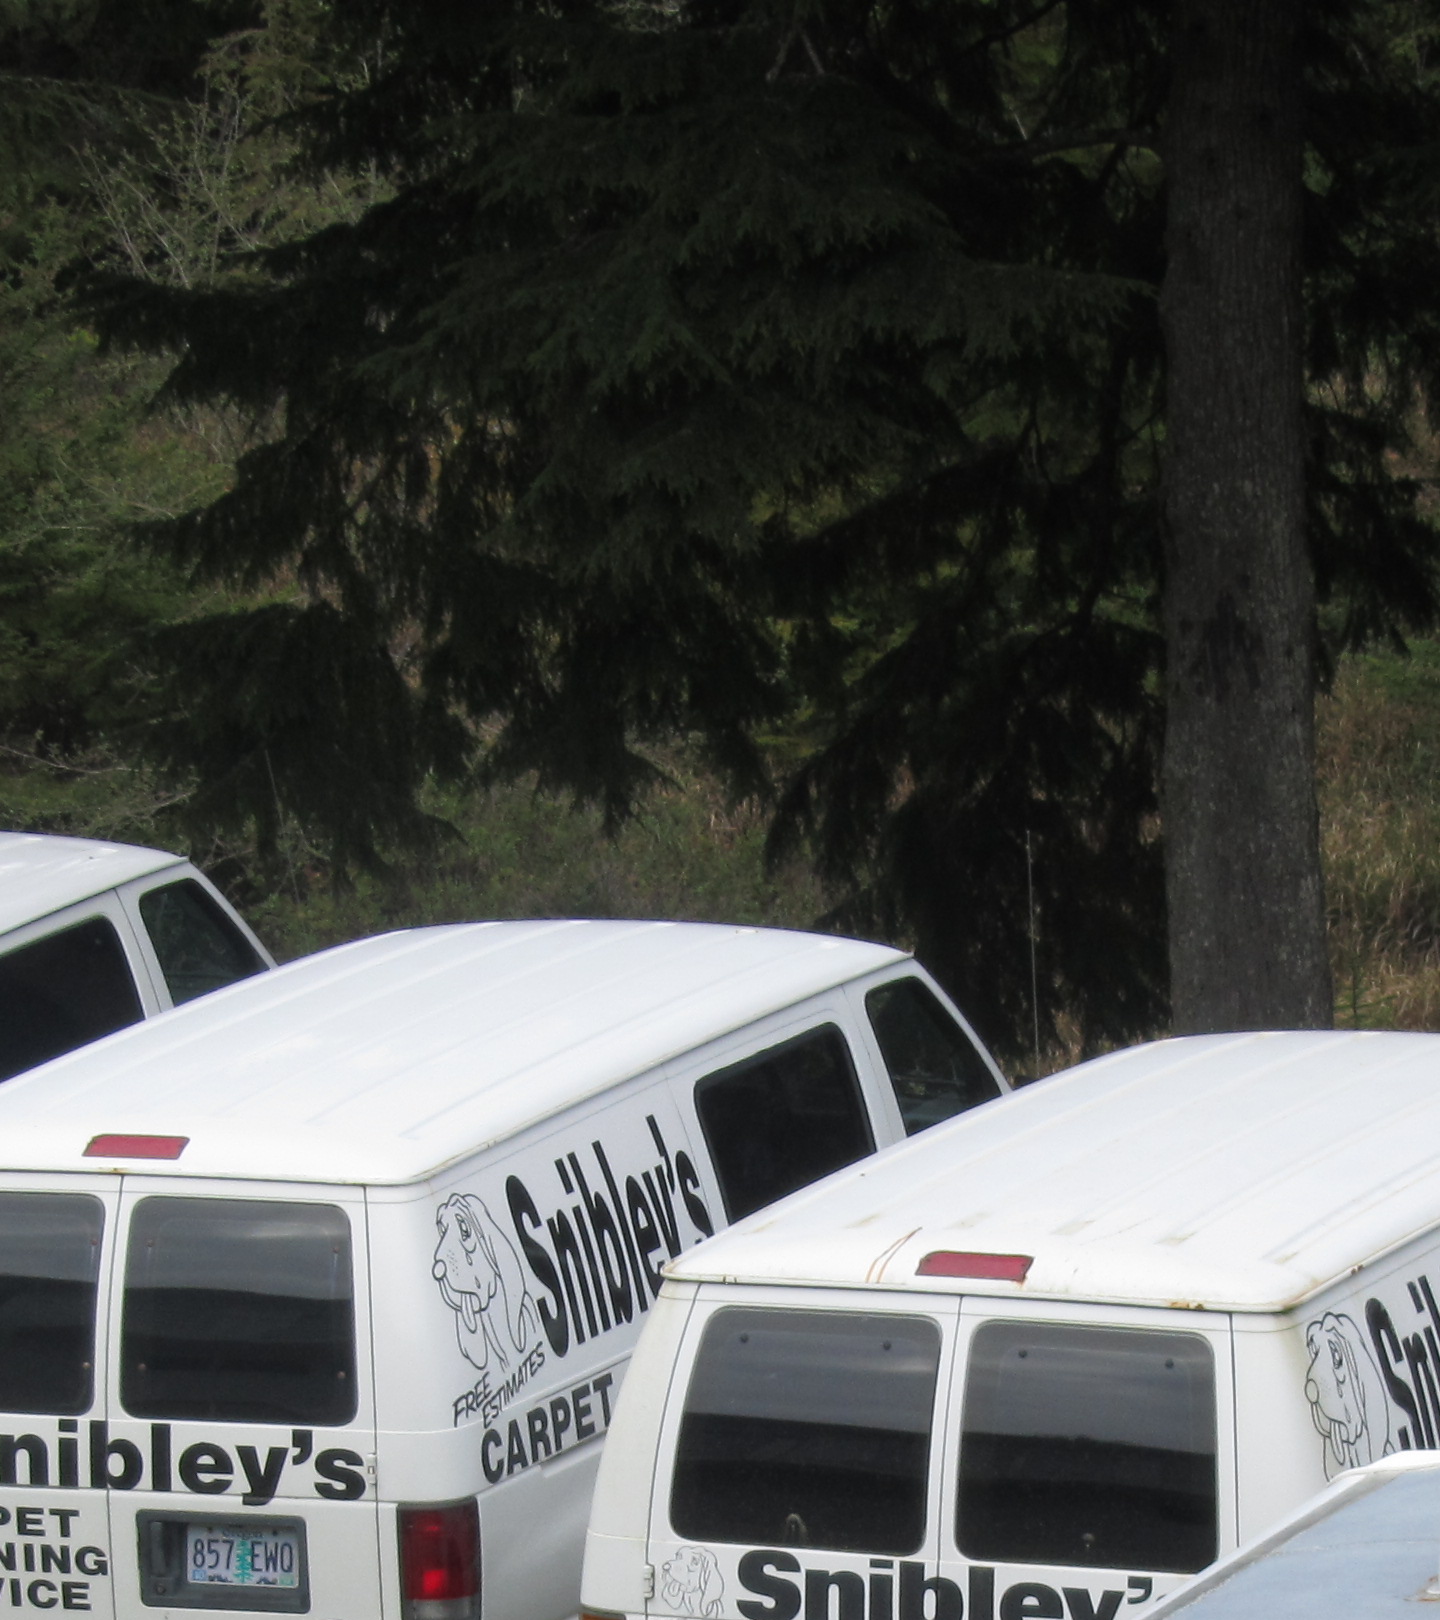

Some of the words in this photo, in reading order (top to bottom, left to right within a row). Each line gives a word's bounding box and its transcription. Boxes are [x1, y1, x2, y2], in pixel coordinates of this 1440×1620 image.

[452, 1372, 493, 1428] FREE
[482, 1341, 545, 1429] ESTIMATES
[481, 1373, 613, 1484] CARPET
[192, 1539, 234, 1570] 857
[250, 1541, 294, 1573] EWQ
